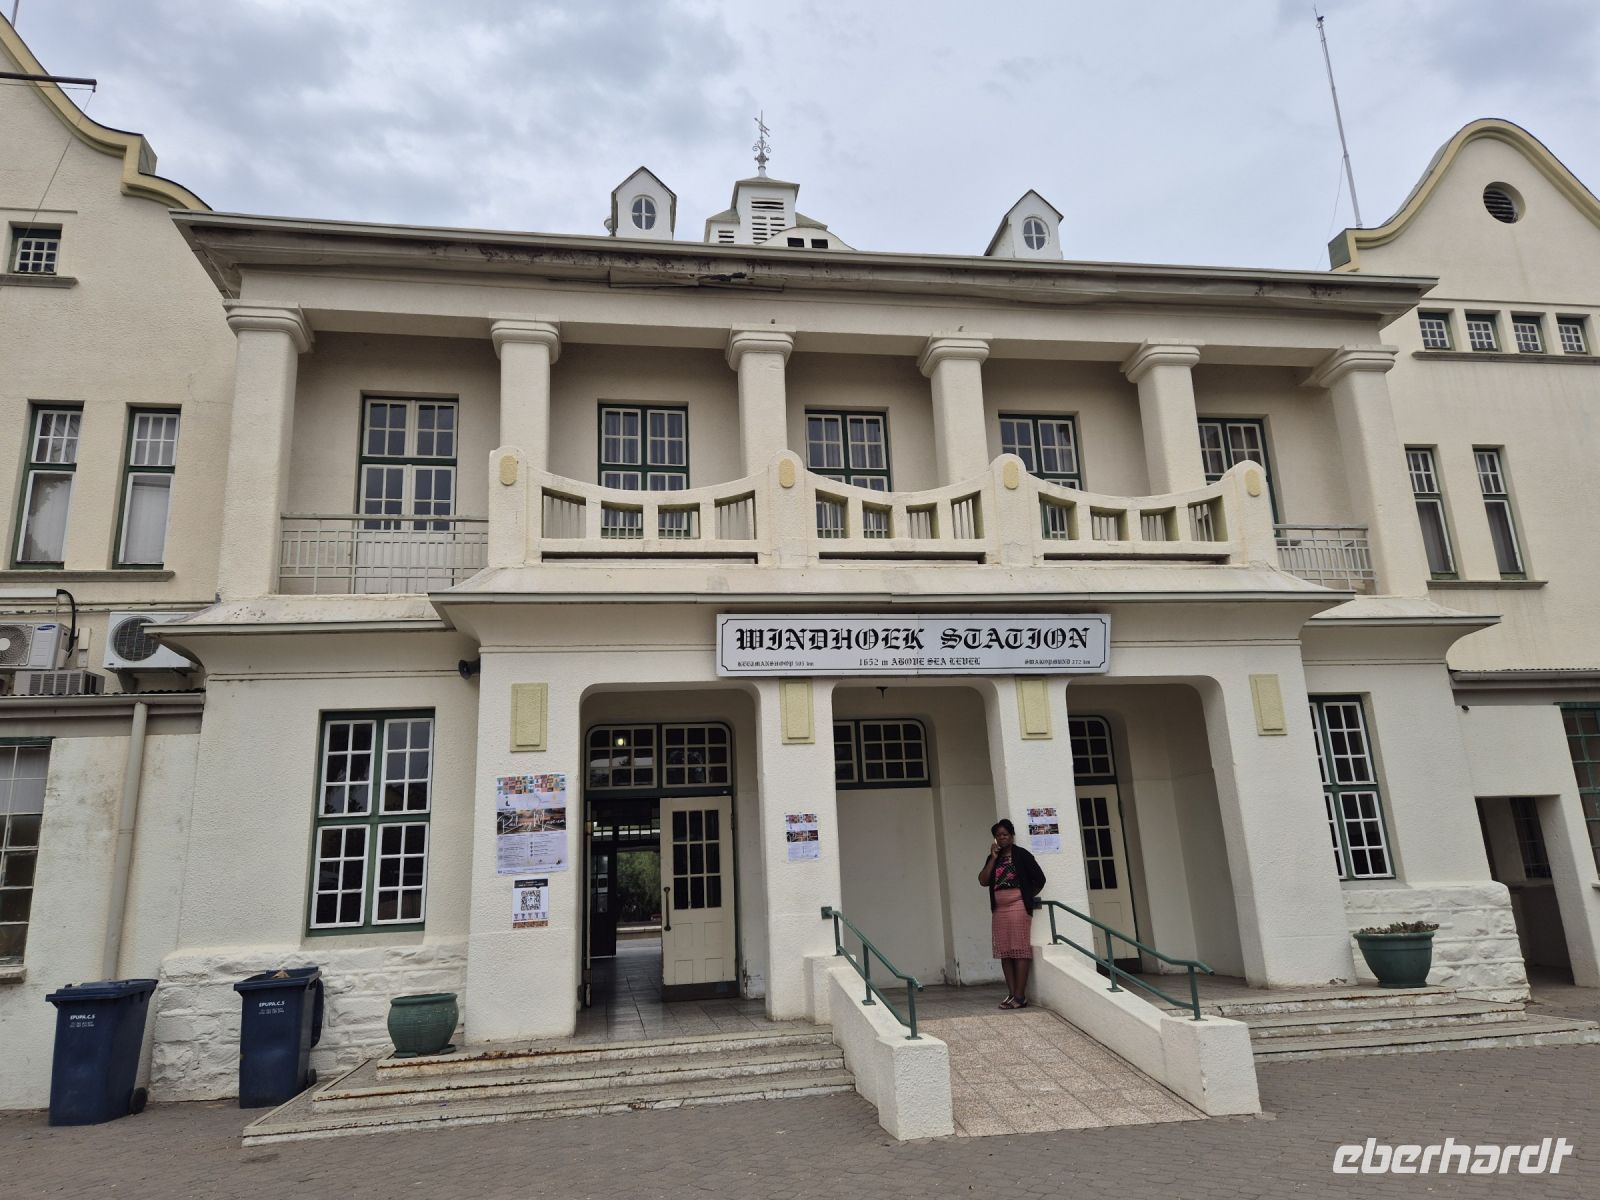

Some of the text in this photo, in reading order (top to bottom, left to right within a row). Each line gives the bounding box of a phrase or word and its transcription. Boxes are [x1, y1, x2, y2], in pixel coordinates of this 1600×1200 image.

[736, 626, 1090, 651] WINDHOEK STATION
[859, 658, 879, 666] 1652
[891, 657, 924, 666] ABOVE
[927, 657, 947, 666] SEA
[949, 657, 981, 666] LEVEL
